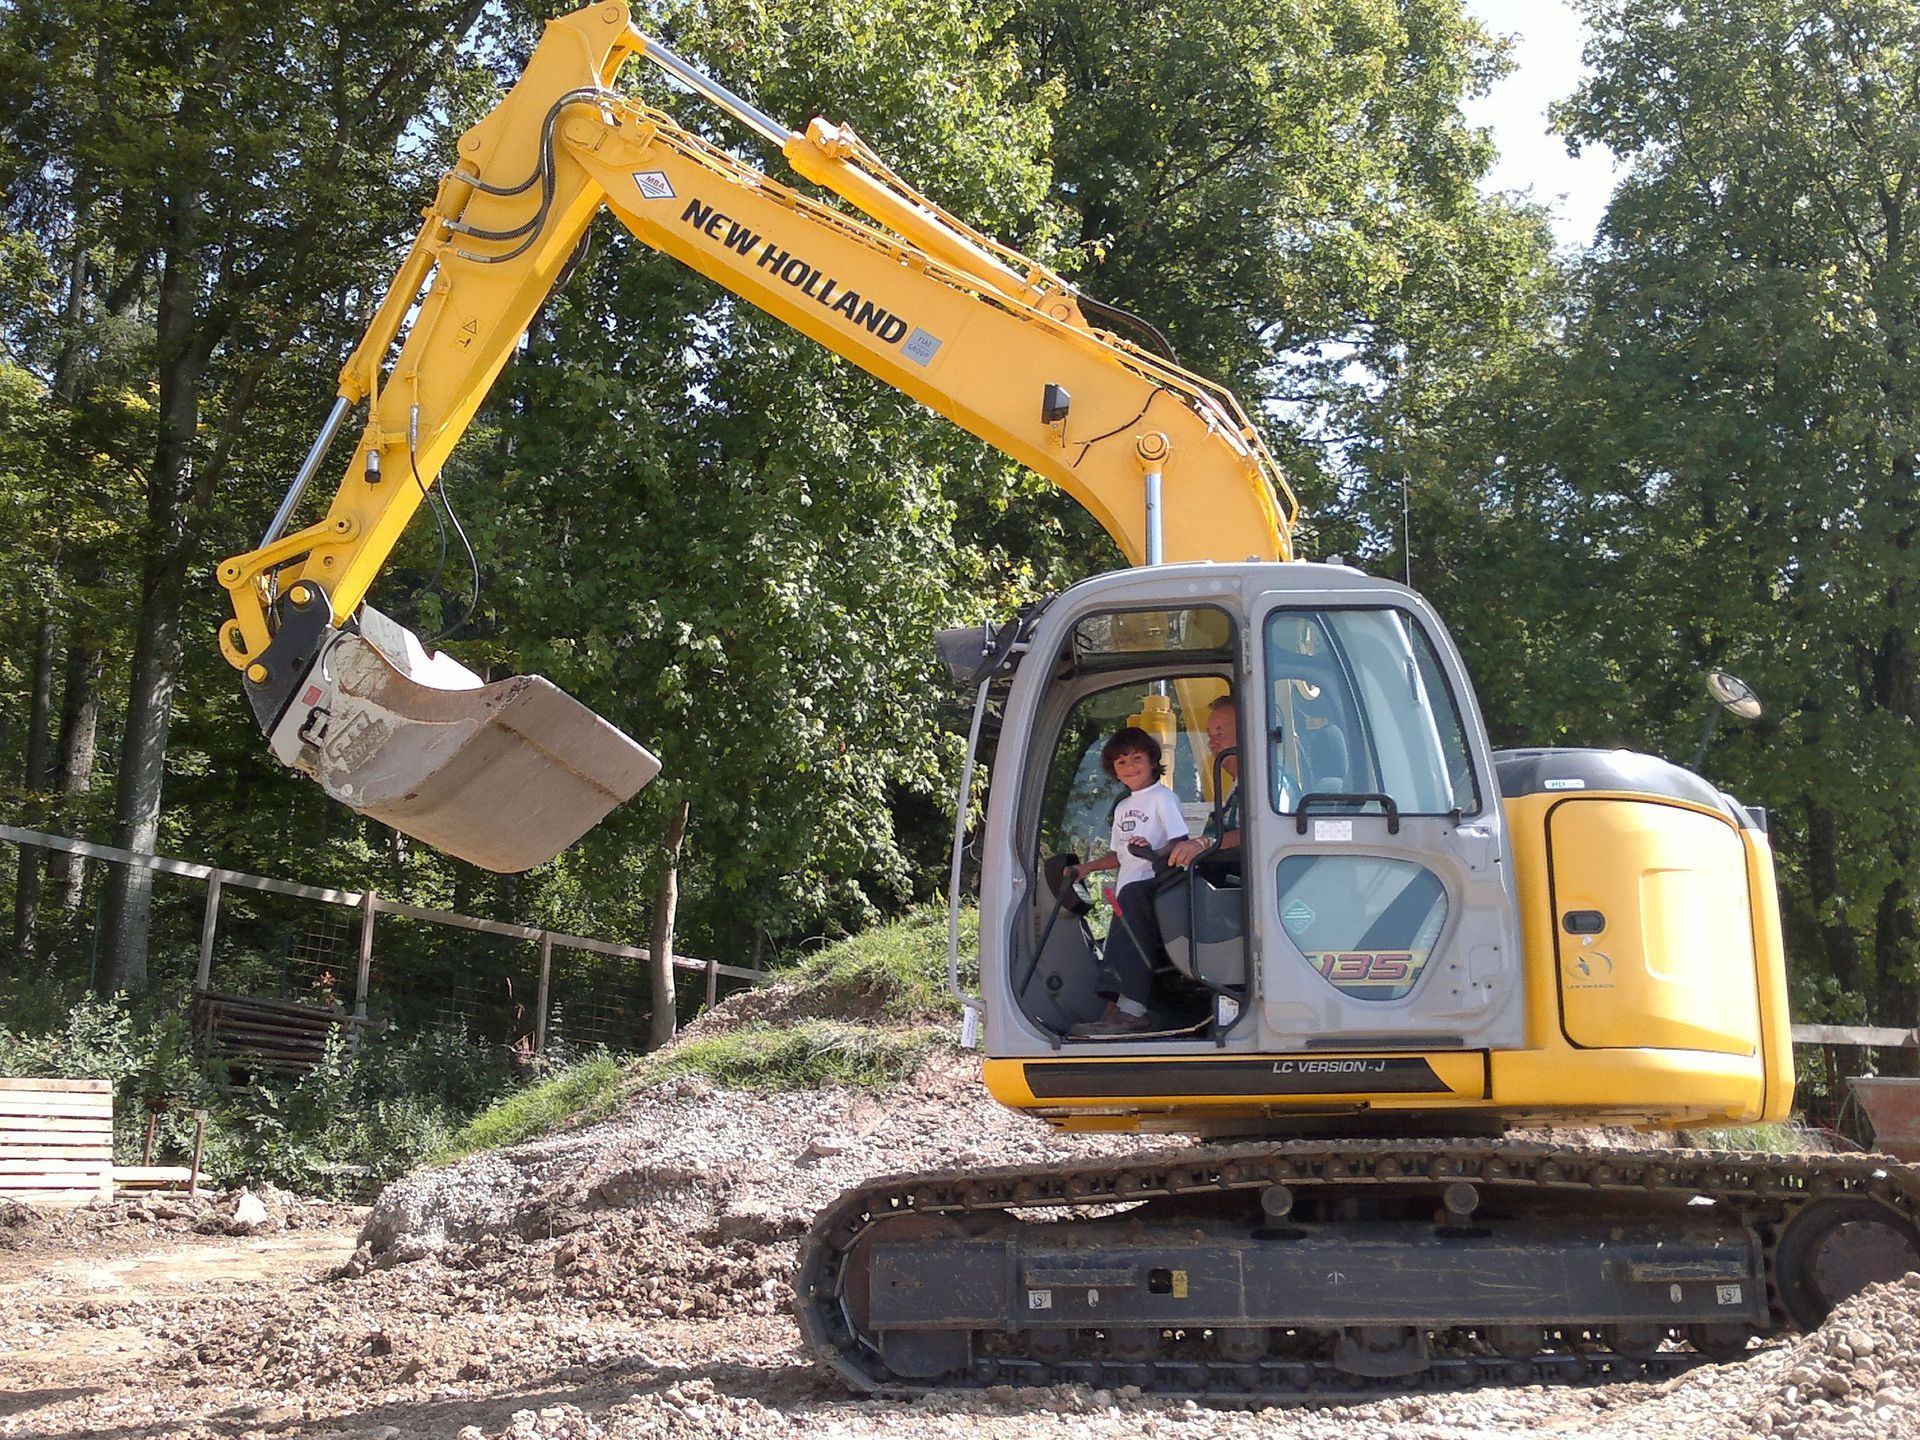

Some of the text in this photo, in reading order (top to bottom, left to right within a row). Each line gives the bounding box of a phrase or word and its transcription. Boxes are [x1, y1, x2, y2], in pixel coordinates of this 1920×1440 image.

[645, 175, 665, 190] MBA
[680, 198, 908, 344] NEW HOLLAND
[907, 343, 930, 358] GROUP
[1272, 1062, 1293, 1073] LC
